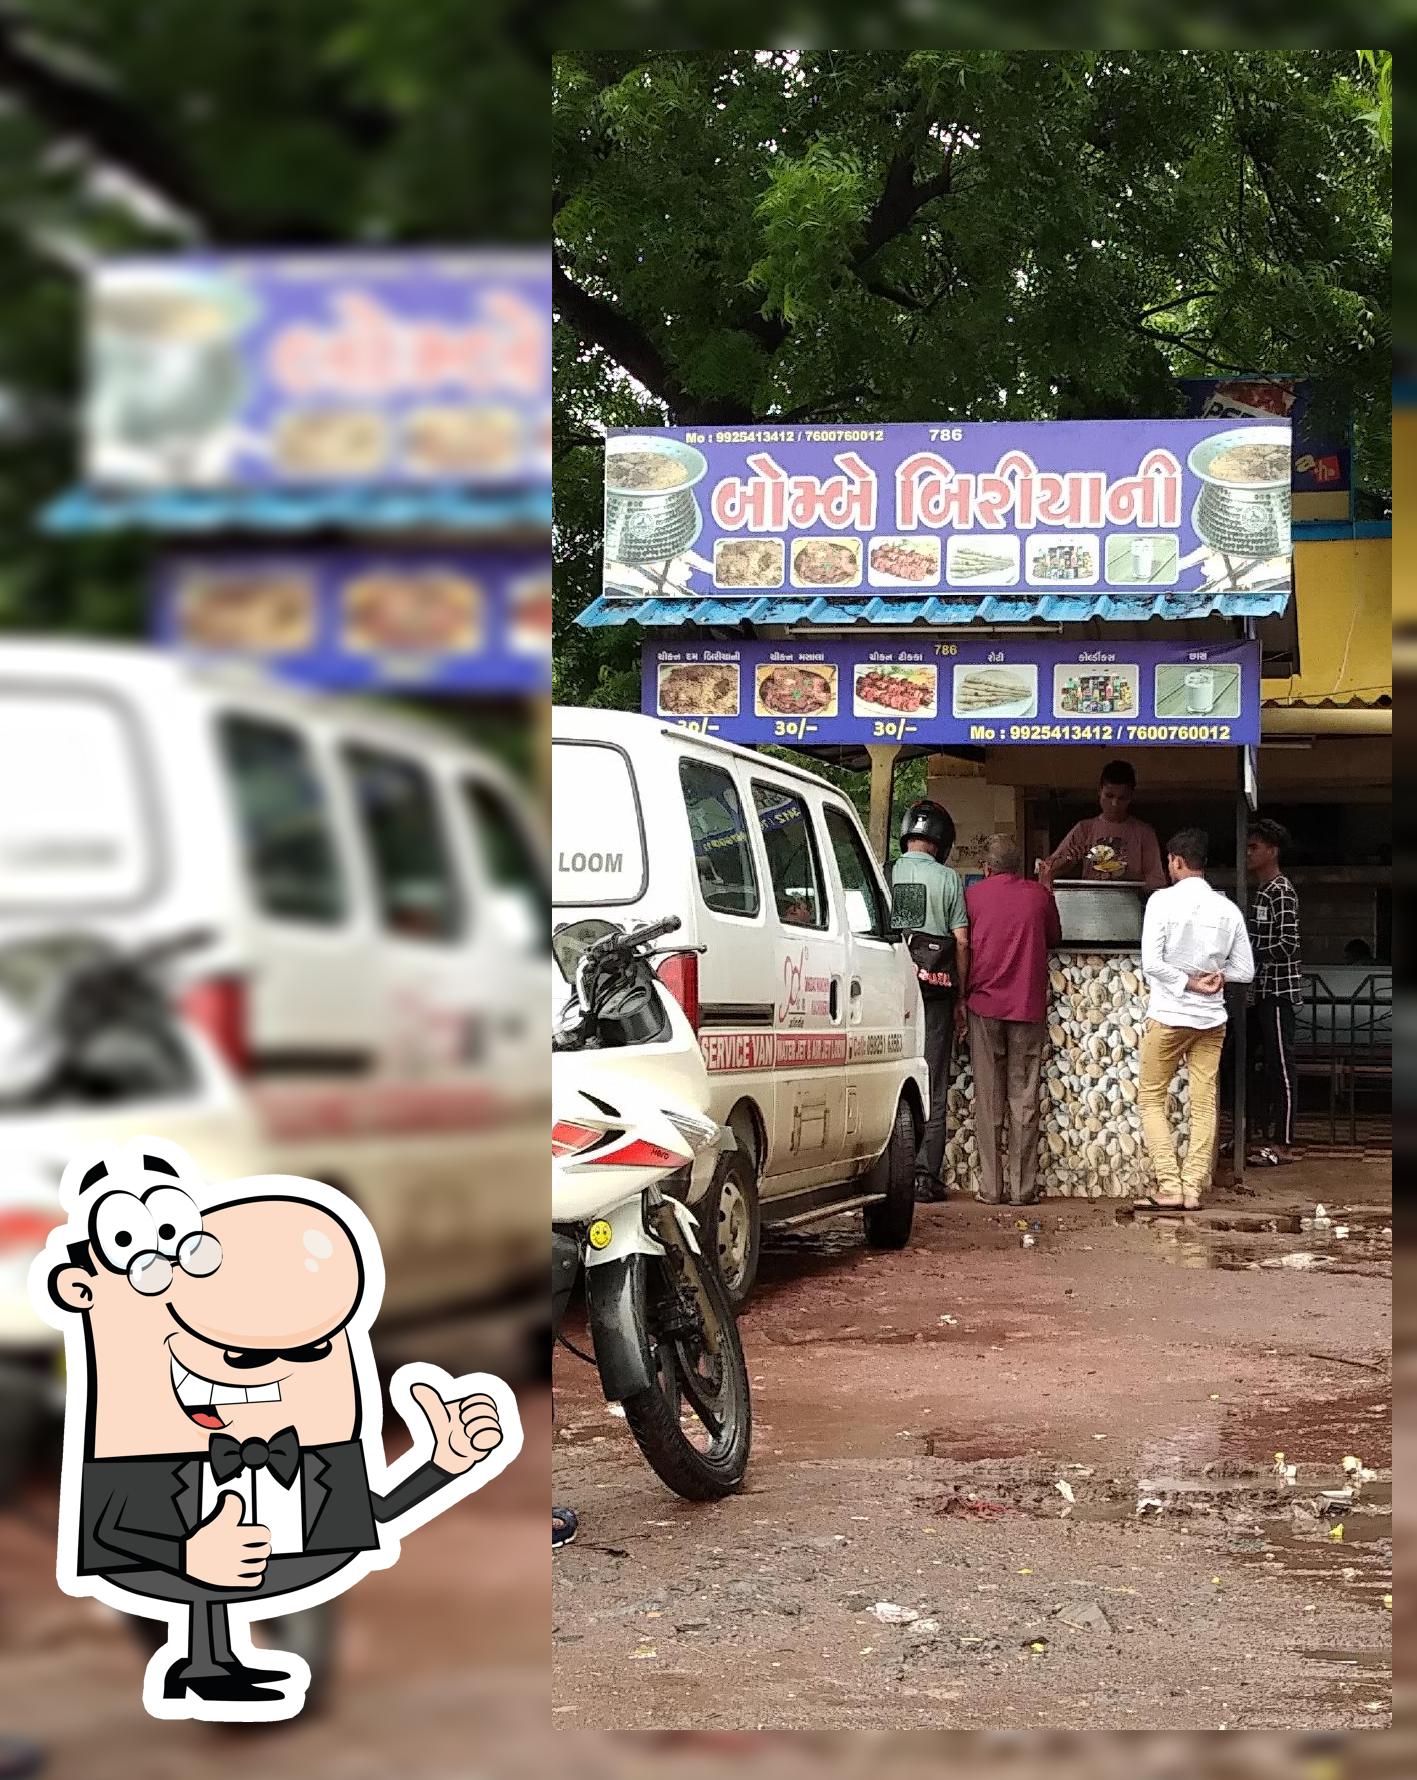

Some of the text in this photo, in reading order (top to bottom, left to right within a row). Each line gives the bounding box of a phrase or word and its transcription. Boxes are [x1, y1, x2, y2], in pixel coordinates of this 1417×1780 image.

[686, 433, 705, 443] Mo
[716, 431, 794, 443] 9925413412
[805, 430, 884, 442] 7600760012
[928, 428, 963, 442] 786
[711, 449, 1182, 531] બોમ્બે બિરીયાની
[934, 644, 957, 656] 786
[987, 651, 1004, 662] રોટી
[774, 718, 818, 740] 30/-
[873, 718, 917, 740] 30/-
[970, 725, 995, 740] Mo
[1010, 725, 1113, 740] 9925413412
[1127, 725, 1230, 740] 7600760012
[558, 852, 623, 872] LOOM
[701, 1035, 773, 1069] SERVICE VAN
